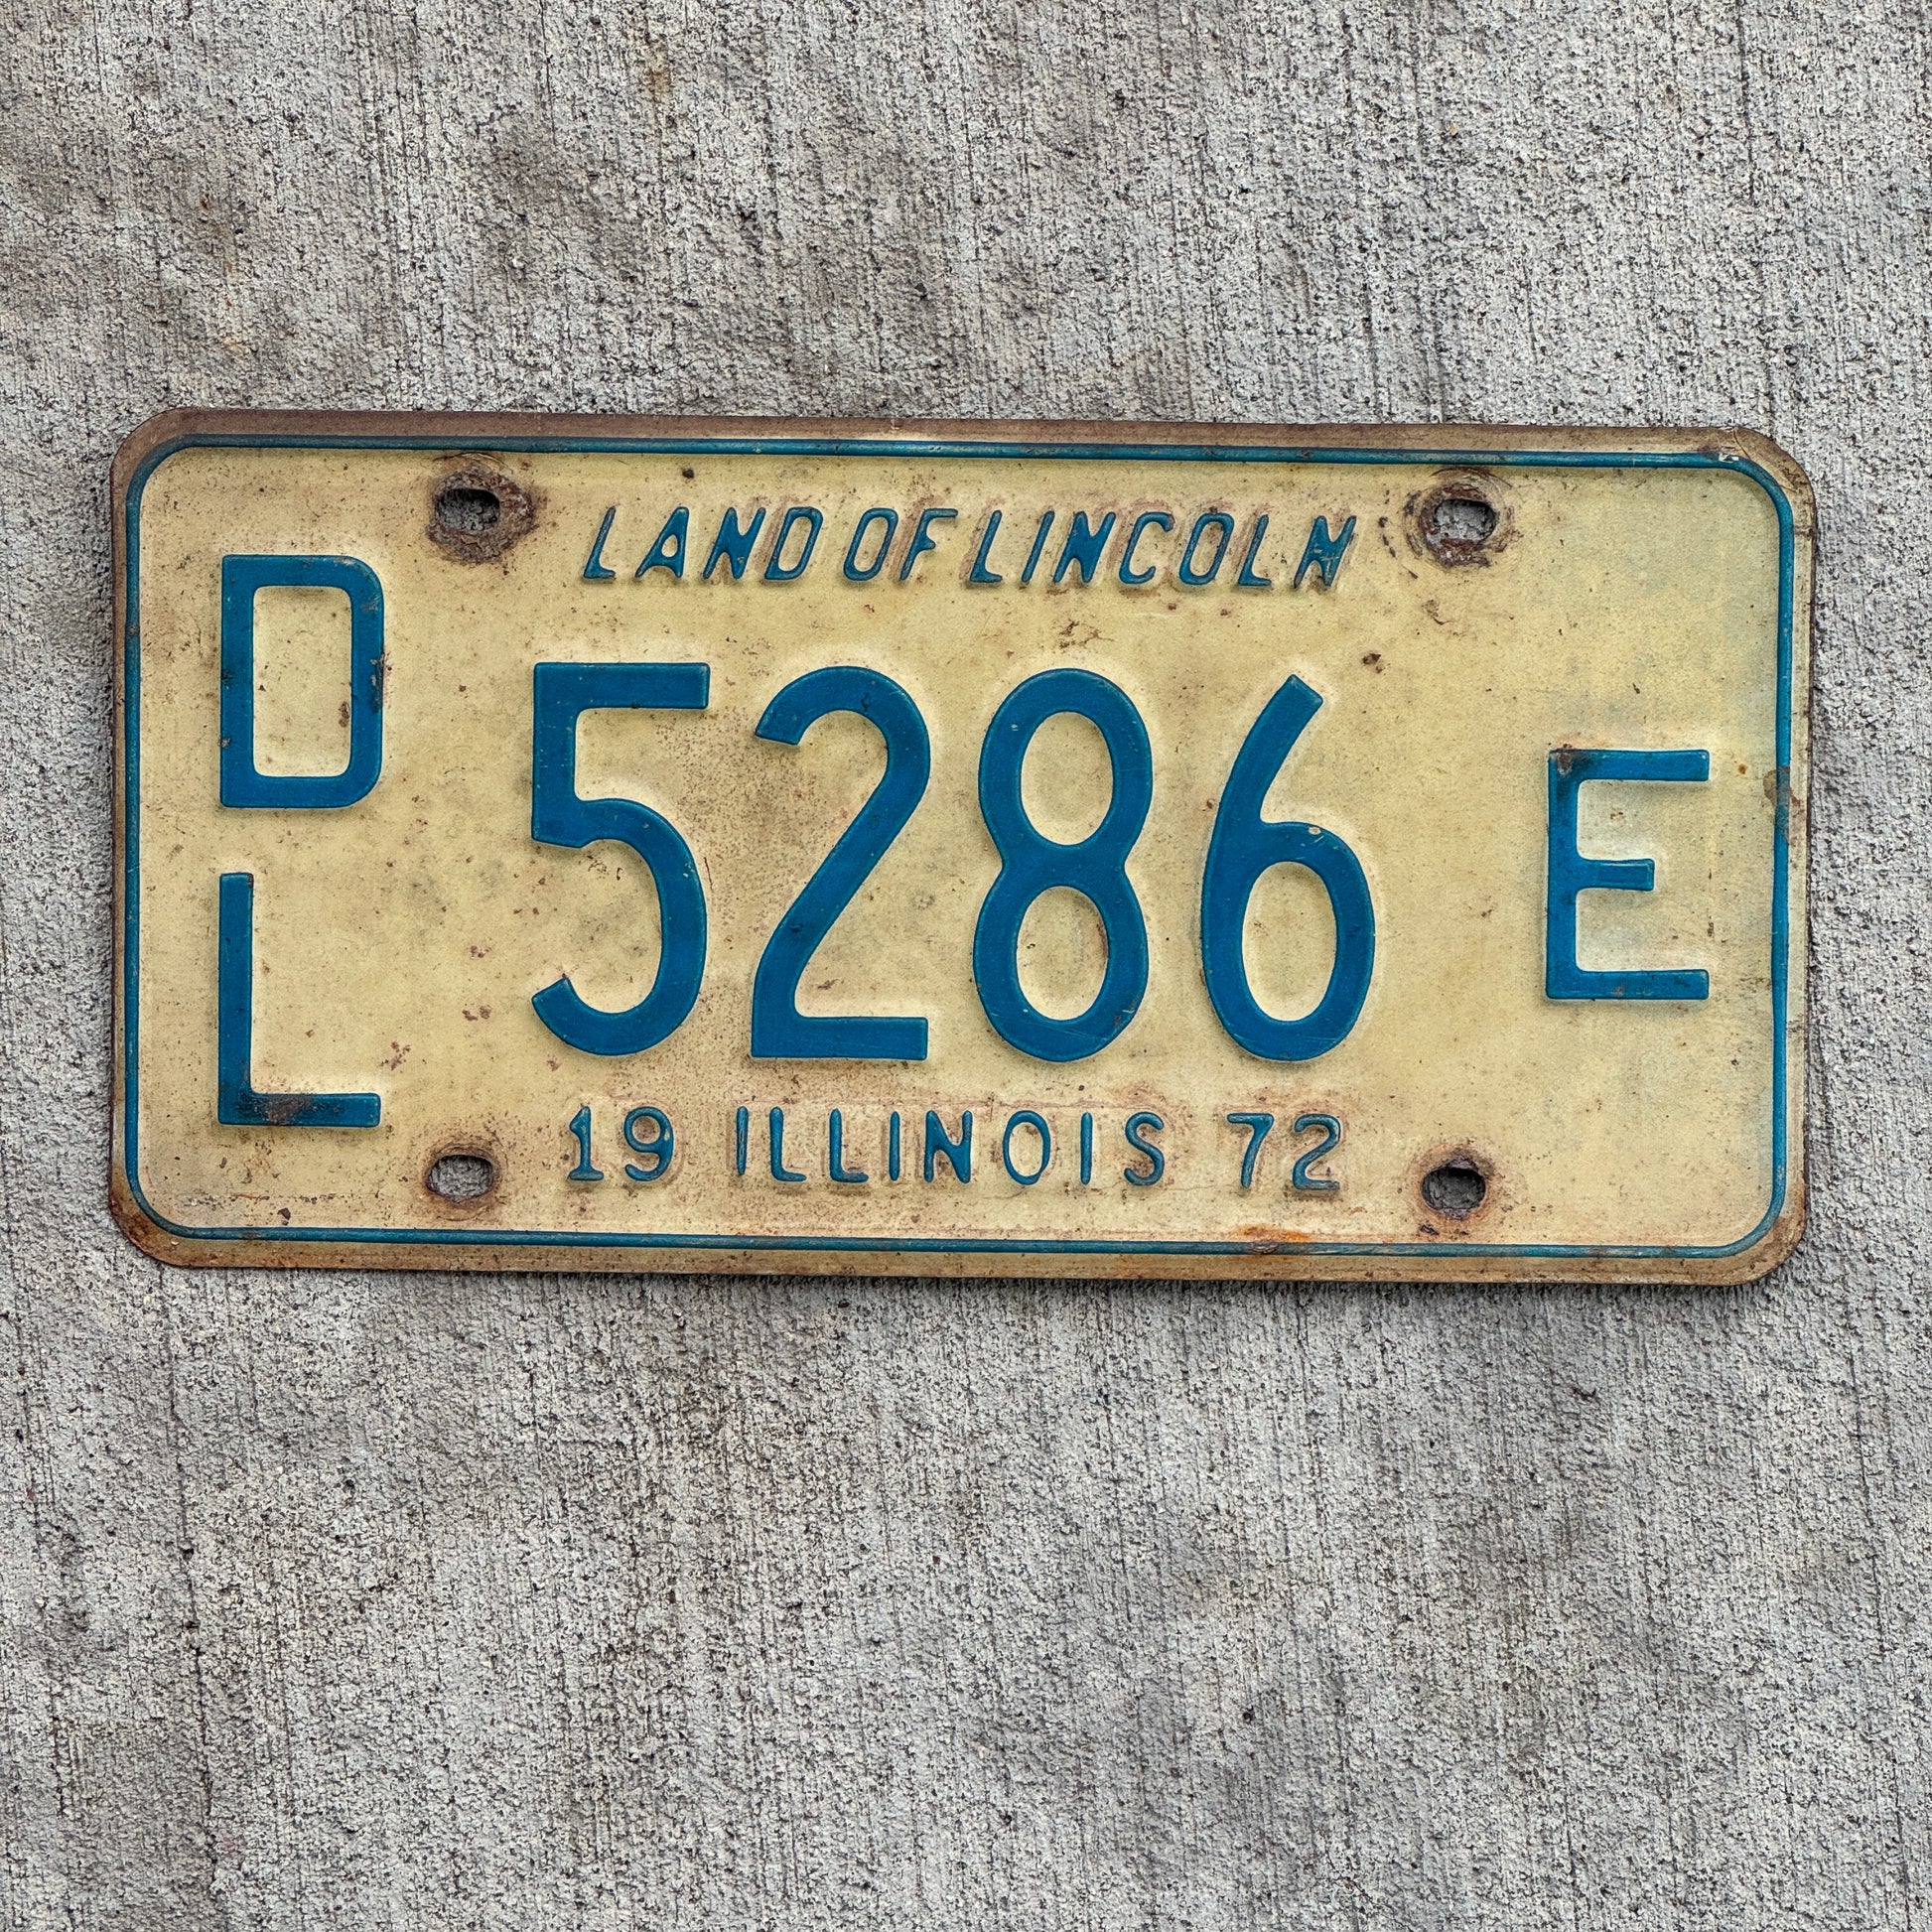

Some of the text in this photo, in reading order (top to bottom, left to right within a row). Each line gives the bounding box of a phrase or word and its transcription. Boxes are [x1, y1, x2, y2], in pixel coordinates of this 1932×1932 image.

[583, 505, 1357, 589] LAND OF LINCOLN
[531, 661, 1711, 1063] 5286 E
[567, 1106, 1341, 1190] 19 ILLINOIS 72
